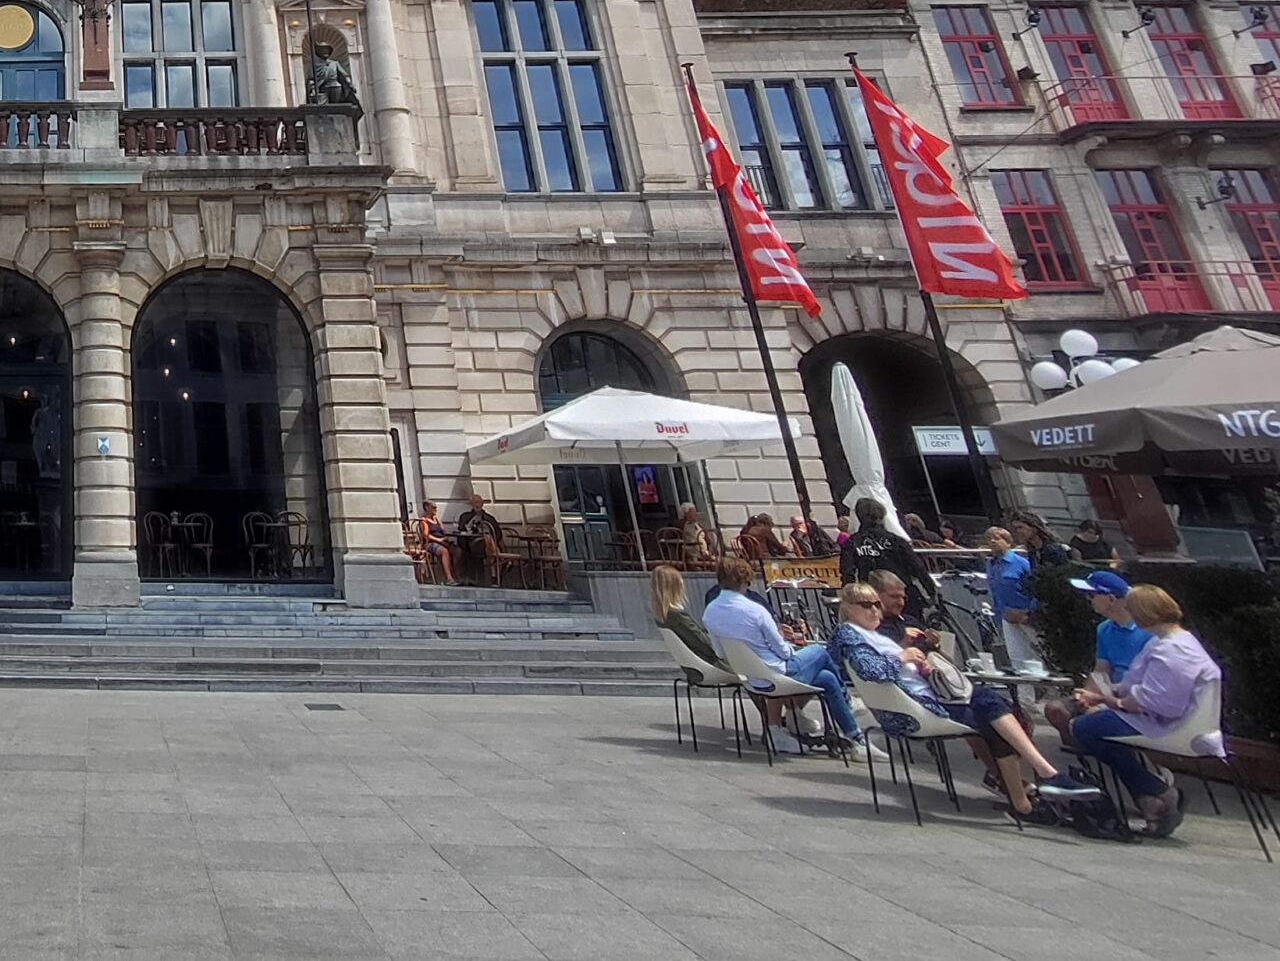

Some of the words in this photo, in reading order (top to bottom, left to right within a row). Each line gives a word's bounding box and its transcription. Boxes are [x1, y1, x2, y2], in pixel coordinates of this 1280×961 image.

[655, 422, 689, 434] Duvel
[1030, 424, 1095, 446] VEDETT
[781, 567, 840, 578] CHOUFF
